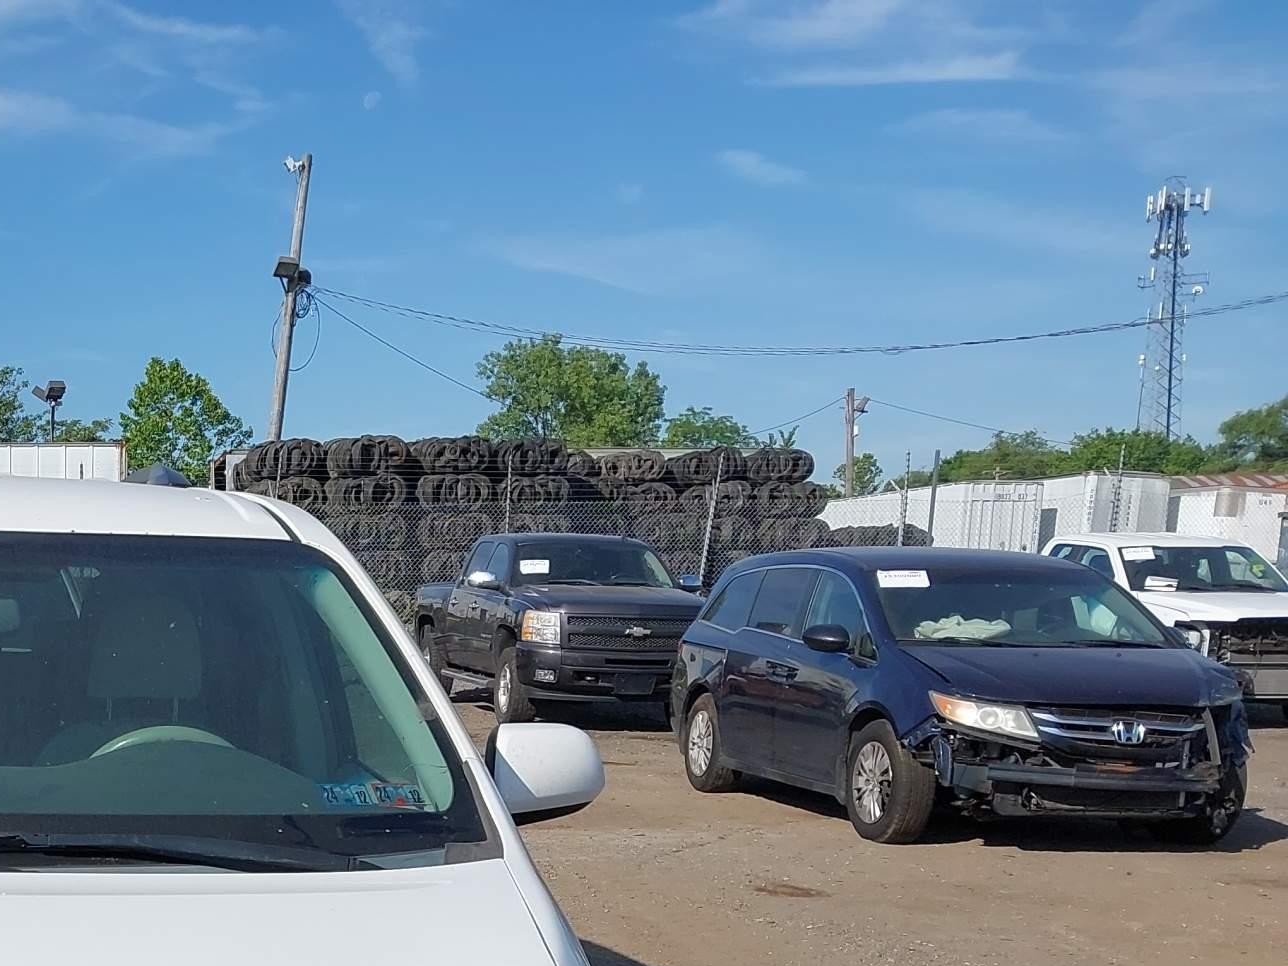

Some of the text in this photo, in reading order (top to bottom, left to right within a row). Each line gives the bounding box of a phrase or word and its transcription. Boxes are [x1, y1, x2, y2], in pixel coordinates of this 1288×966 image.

[322, 786, 371, 804] 24 12
[375, 786, 425, 804] 24 12
